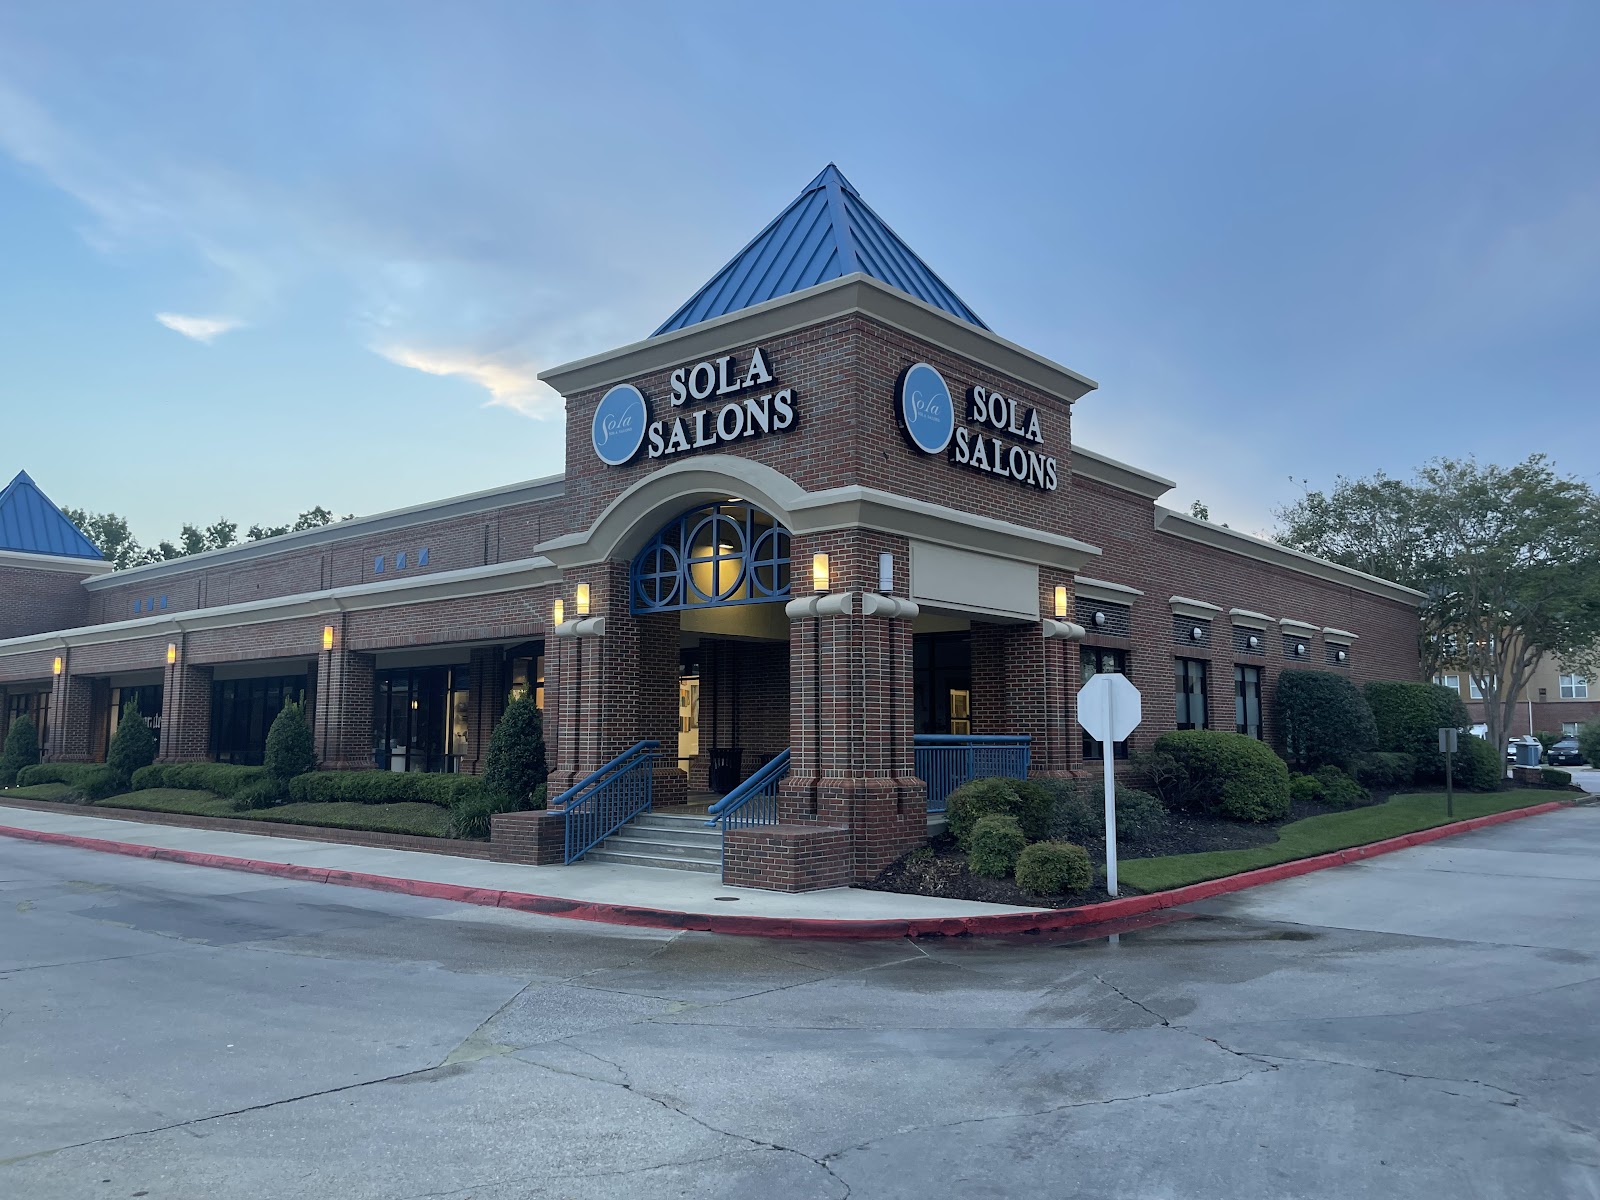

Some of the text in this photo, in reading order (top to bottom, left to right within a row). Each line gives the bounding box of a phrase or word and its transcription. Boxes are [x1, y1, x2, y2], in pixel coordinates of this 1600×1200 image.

[670, 346, 773, 407] SOLA
[908, 390, 947, 423] Sola
[597, 402, 640, 446] Sola
[648, 388, 794, 459] SALONS
[973, 385, 1045, 444] SOLA
[955, 426, 1058, 491] SALONS
